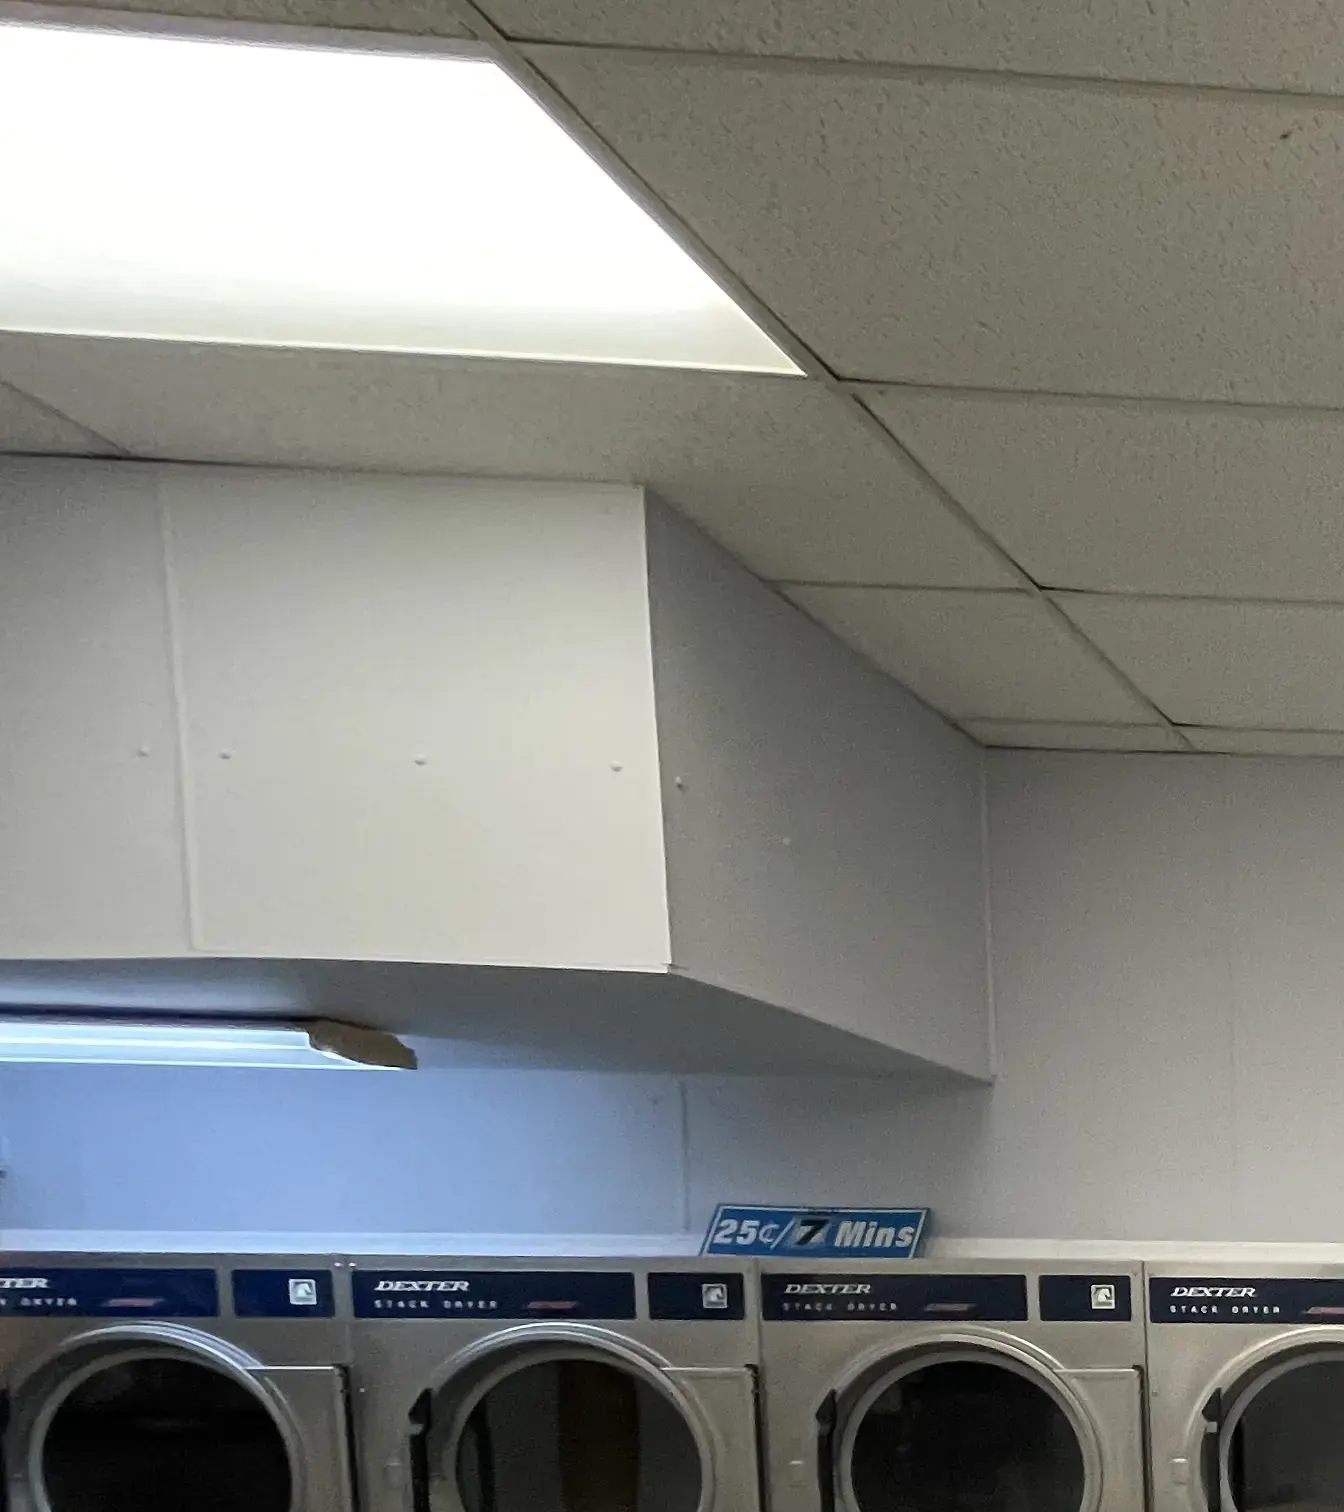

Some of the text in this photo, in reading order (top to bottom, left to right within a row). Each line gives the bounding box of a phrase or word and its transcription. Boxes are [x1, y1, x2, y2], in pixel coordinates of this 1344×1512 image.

[834, 1220, 916, 1248] Mins
[374, 1280, 470, 1292] DEXTER
[784, 1283, 871, 1294] DEXTER
[1170, 1286, 1257, 1298] DEXTER
